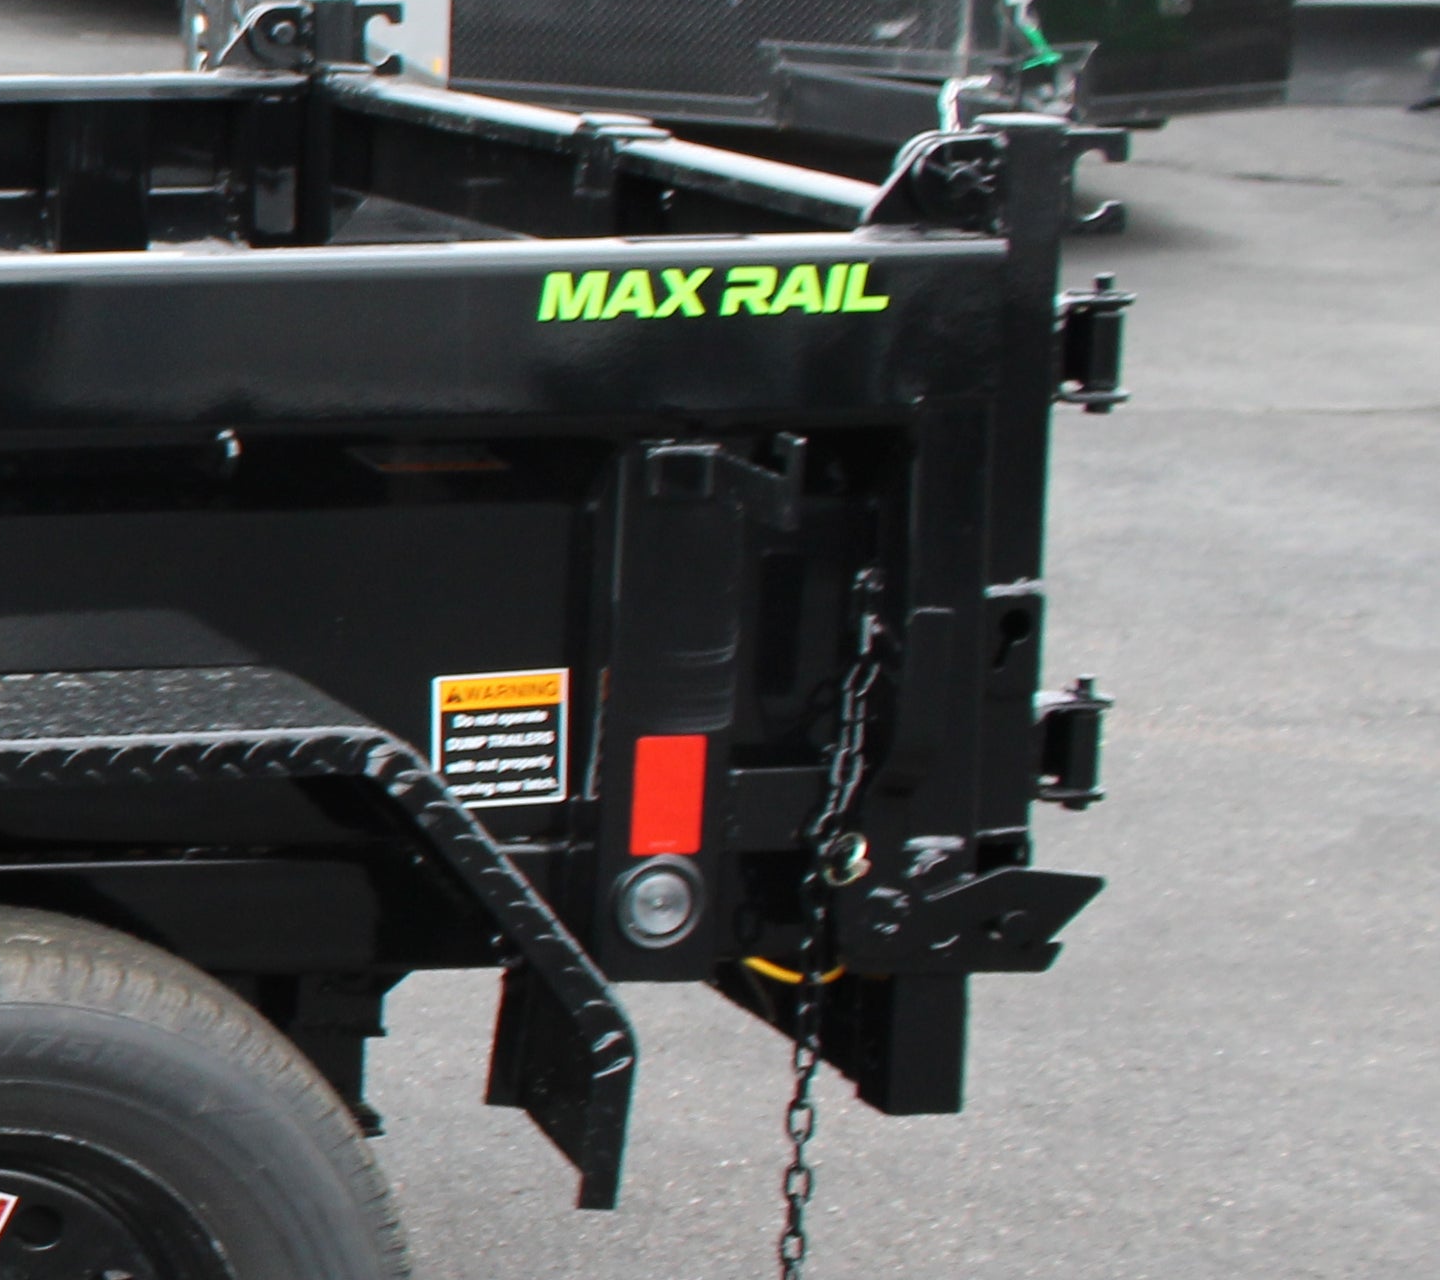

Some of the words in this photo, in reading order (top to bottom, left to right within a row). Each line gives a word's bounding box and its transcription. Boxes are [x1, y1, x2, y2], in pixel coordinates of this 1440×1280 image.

[537, 267, 714, 322] MAX
[719, 263, 890, 317] RAIL
[465, 680, 559, 700] WARNING
